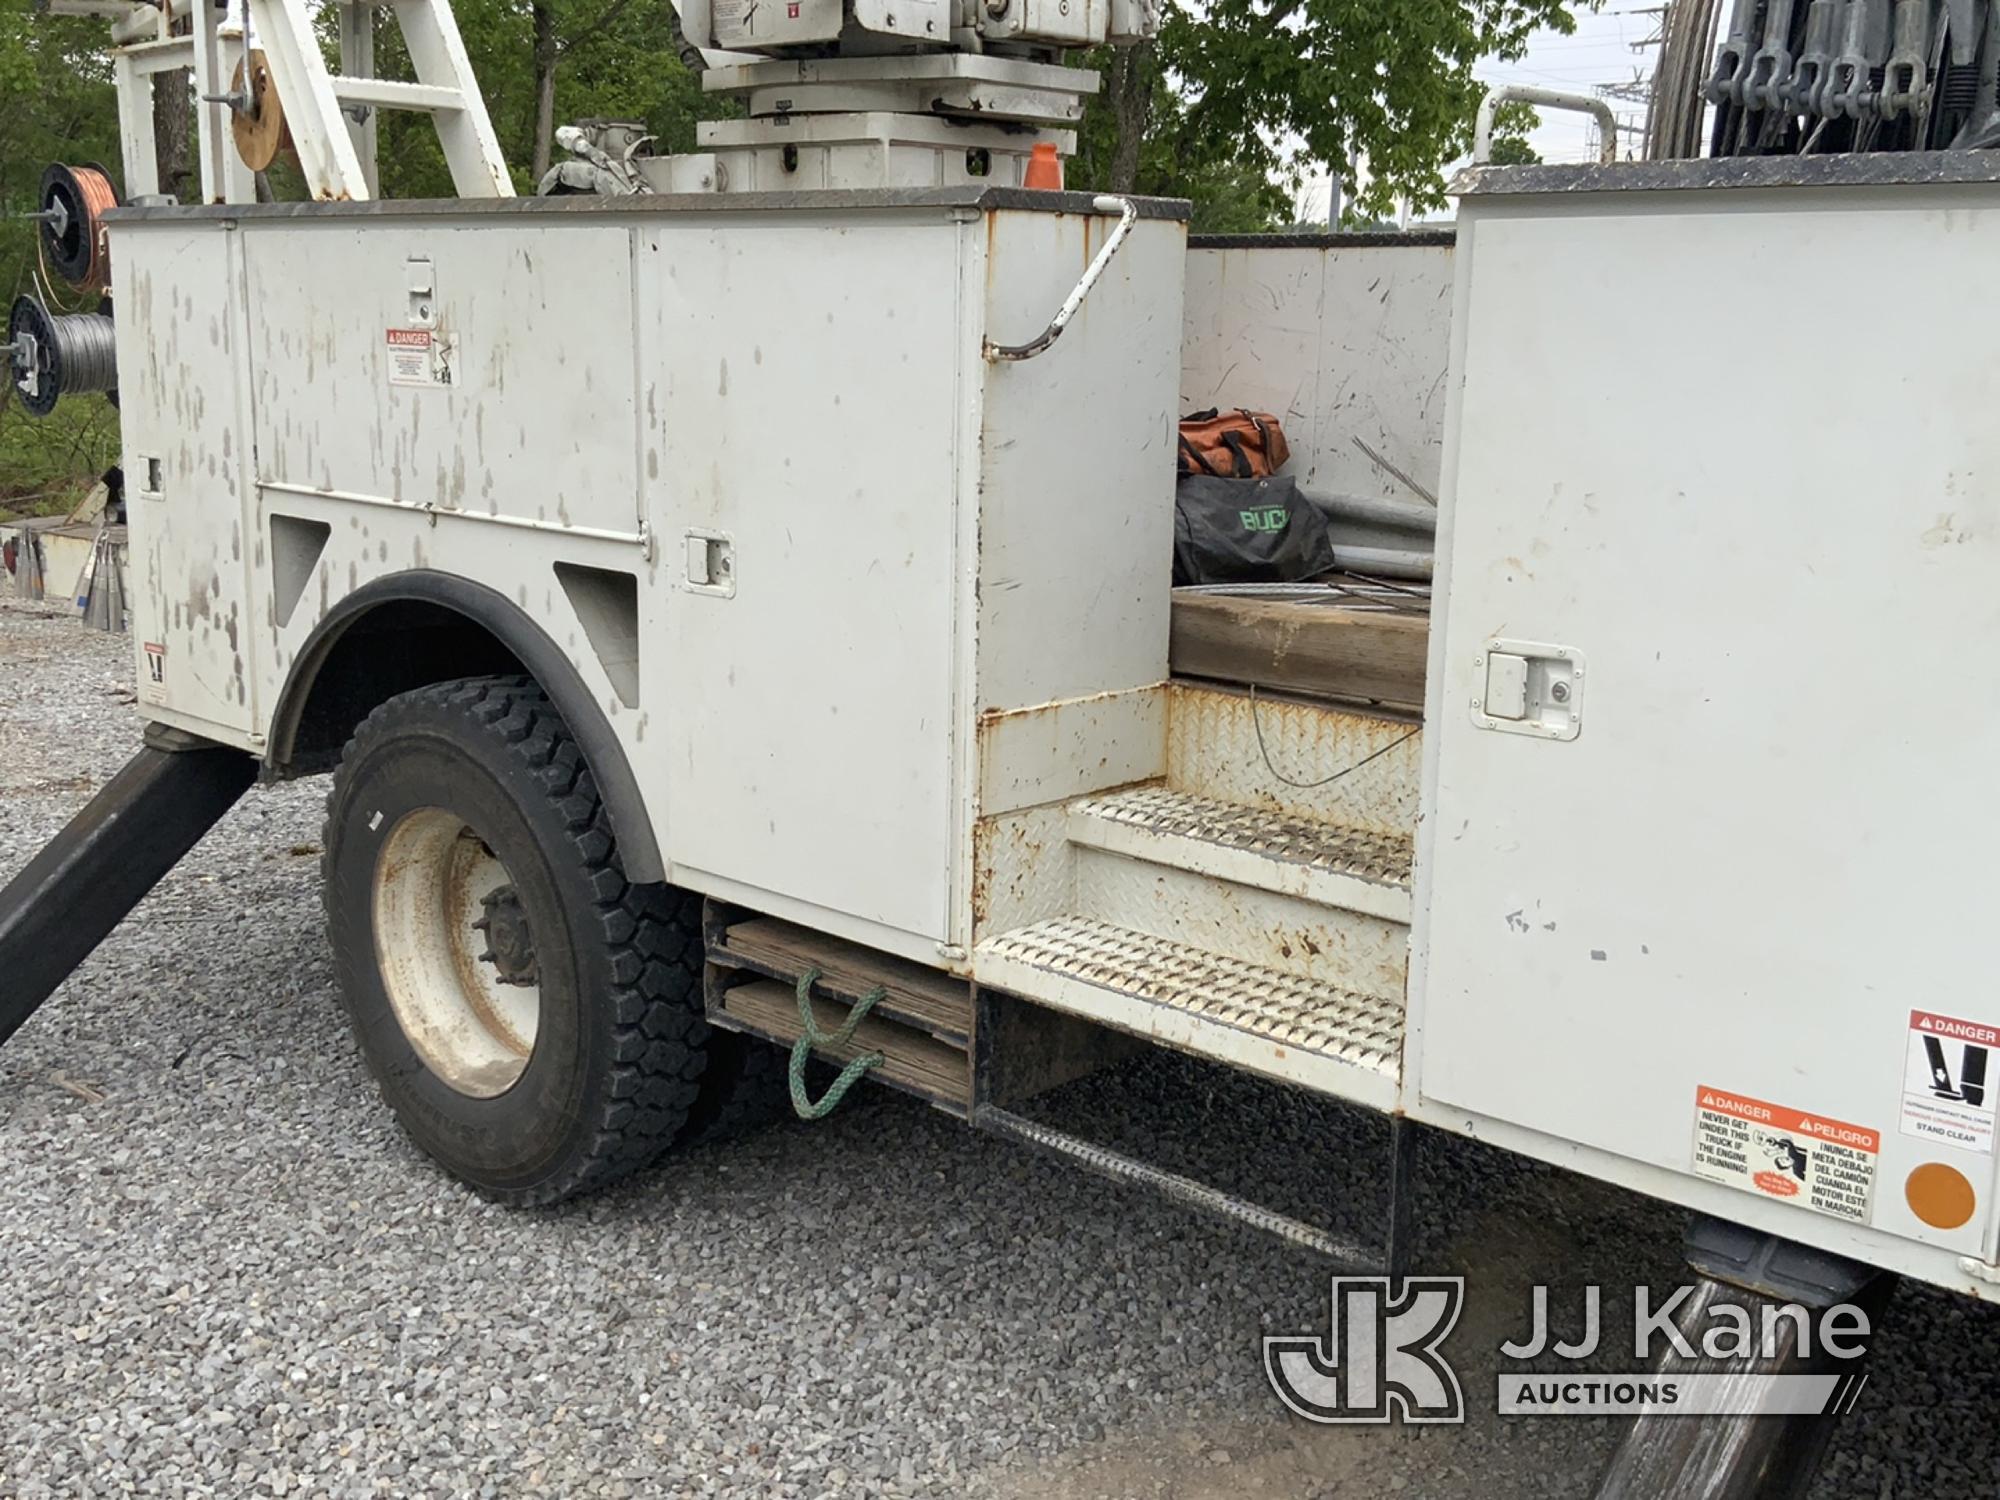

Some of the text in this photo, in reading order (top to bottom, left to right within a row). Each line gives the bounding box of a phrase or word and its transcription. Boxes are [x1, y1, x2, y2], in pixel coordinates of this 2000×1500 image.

[396, 333, 429, 345] DANGER
[1935, 1019, 1996, 1043] DANGER
[1715, 1097, 1771, 1121] DANGER
[1702, 1111, 1748, 1130] NEVER GET
[1699, 1121, 1750, 1142] UNDER THIS
[1705, 1133, 1743, 1150] TRUCK IF
[1813, 1122, 1872, 1147] PELIGRO
[1916, 1122, 1976, 1143] STAND CLEAR
[1696, 1153, 1704, 1161] IS
[1699, 1142, 1747, 1164] THE ENGINE
[1811, 1151, 1873, 1175] META DEBAJO
[1856, 1152, 1868, 1162] SE
[1814, 1164, 1831, 1176] DEL
[1811, 1185, 1843, 1201] MOTOR
[1854, 1186, 1864, 1196] EL
[1811, 1196, 1823, 1206] EN
[1825, 1201, 1863, 1218] MARCHA
